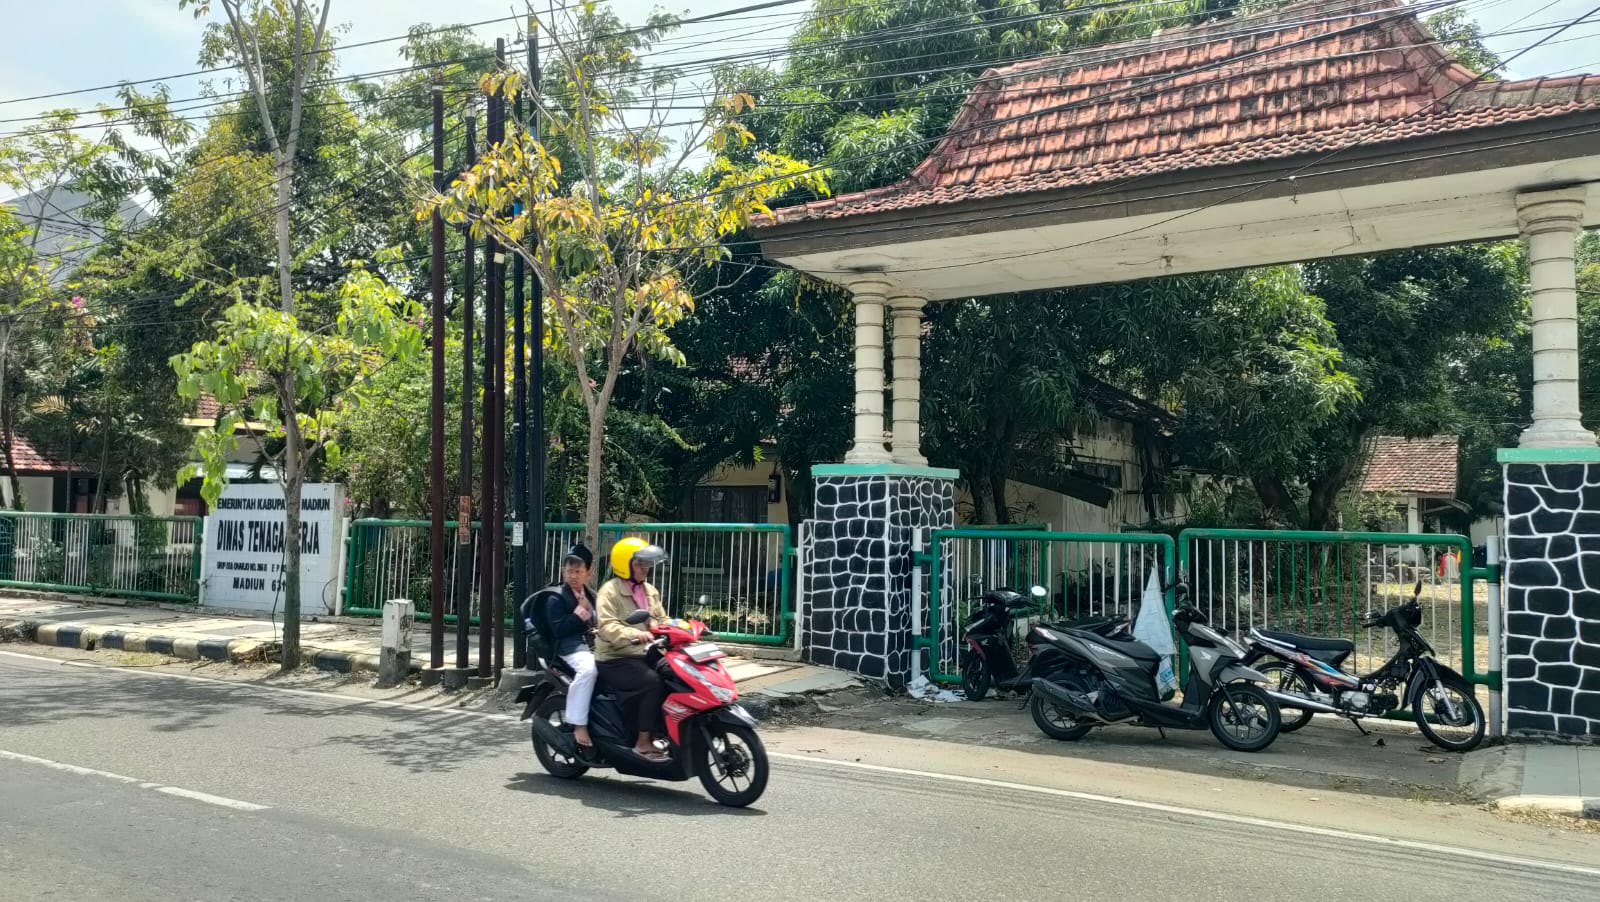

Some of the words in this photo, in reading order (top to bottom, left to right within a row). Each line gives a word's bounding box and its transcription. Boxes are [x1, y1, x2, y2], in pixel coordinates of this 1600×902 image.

[217, 497, 256, 510] EMERINTAH
[257, 498, 286, 510] KABUPA
[301, 498, 331, 511] MADIUN
[217, 520, 244, 550] DINAS
[248, 520, 284, 553] TENAGA
[298, 521, 320, 554] ERJA
[232, 577, 265, 590] MADIUN
